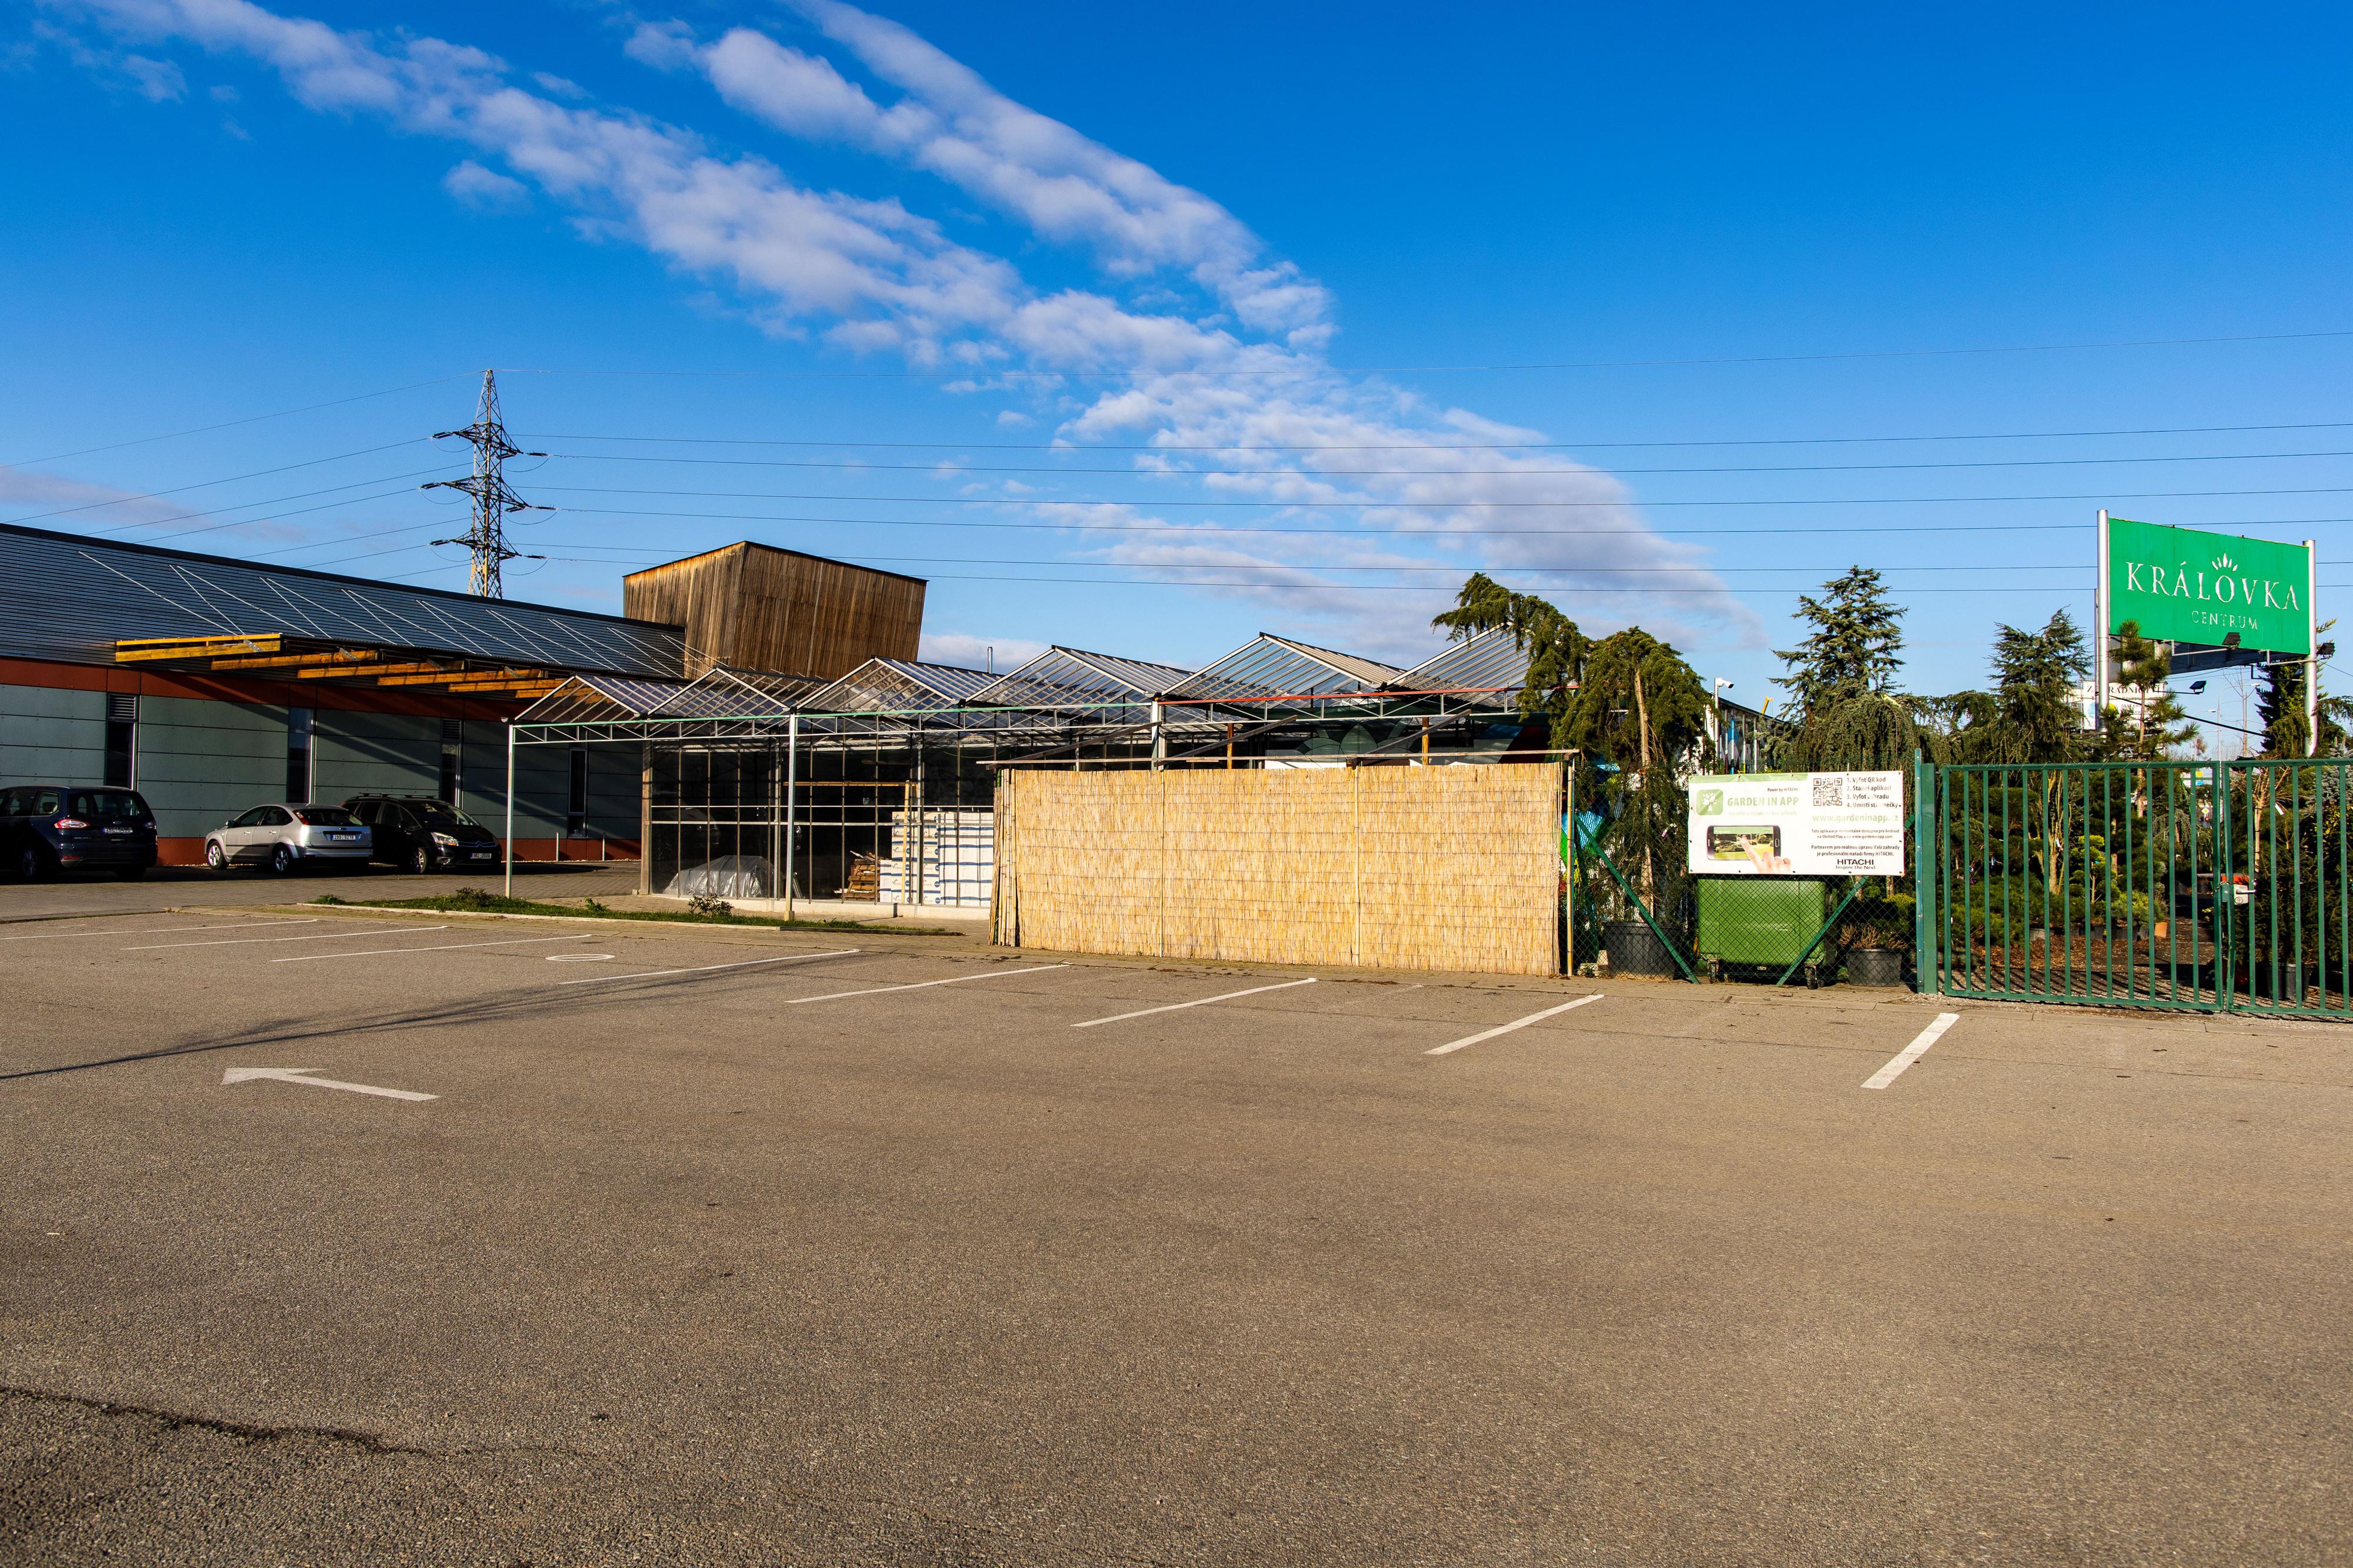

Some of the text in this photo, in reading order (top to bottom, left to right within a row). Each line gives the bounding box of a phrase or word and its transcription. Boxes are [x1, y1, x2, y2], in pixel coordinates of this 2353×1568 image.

[2126, 561, 2299, 611] KRÁLOVKA
[2191, 610, 2258, 630] CENTRUM
[1728, 797, 1799, 806] GARDEN IN APP
